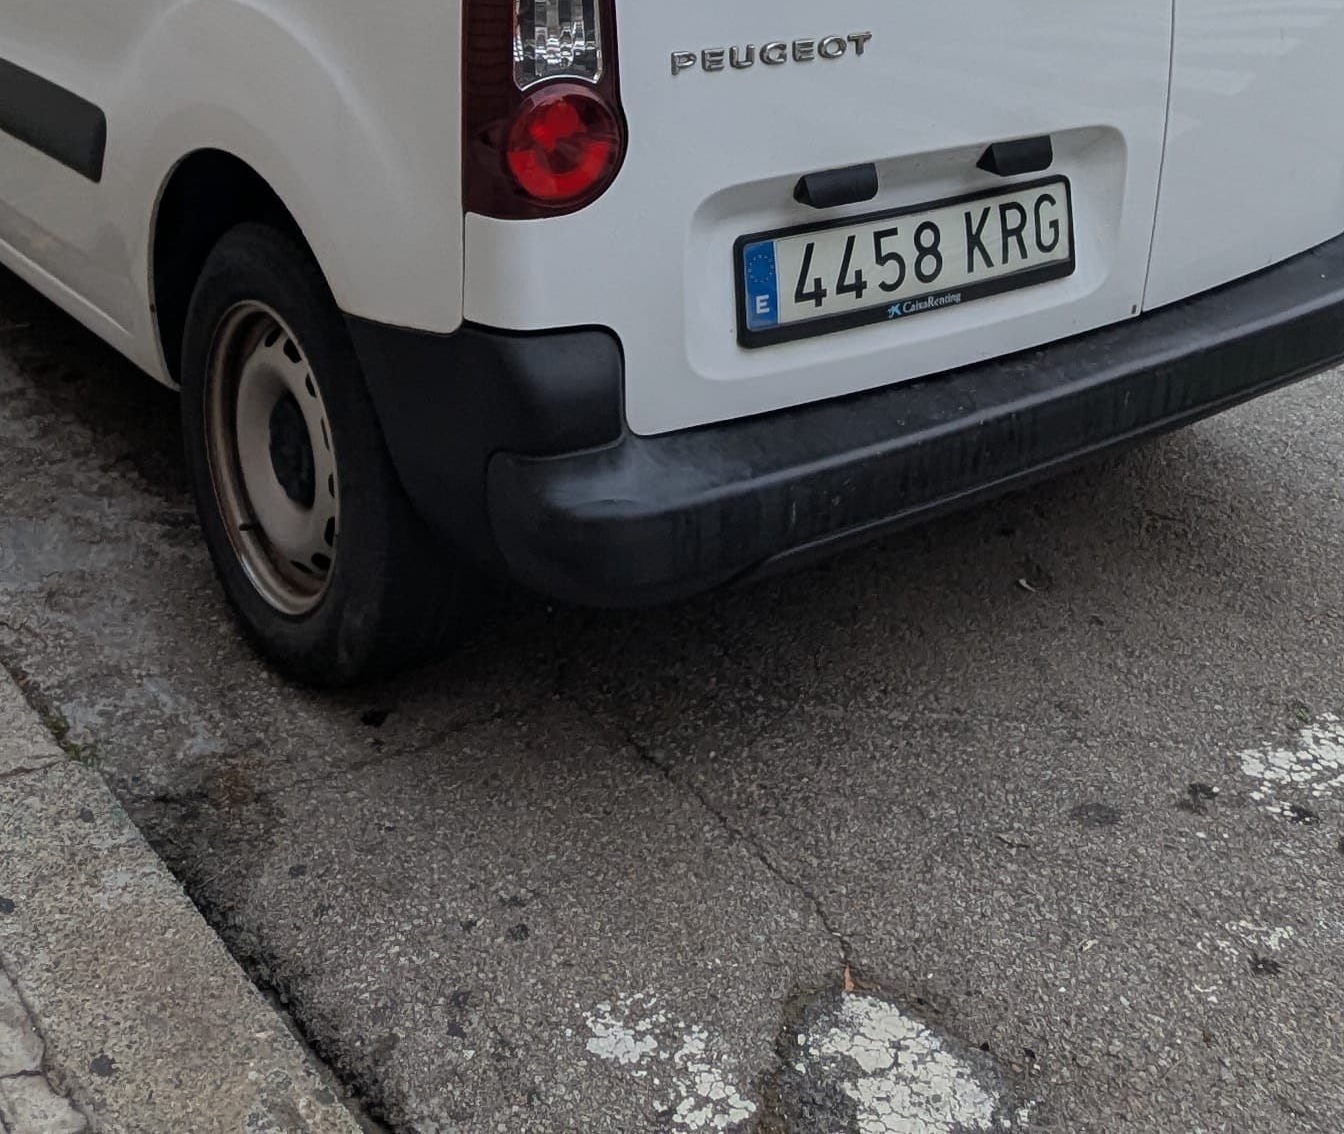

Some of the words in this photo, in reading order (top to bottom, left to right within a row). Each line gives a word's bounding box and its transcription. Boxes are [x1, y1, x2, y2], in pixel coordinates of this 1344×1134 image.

[670, 31, 873, 76] PEUGEOT
[793, 220, 944, 308] 4458
[964, 193, 1061, 274] KRG
[755, 293, 771, 314] E
